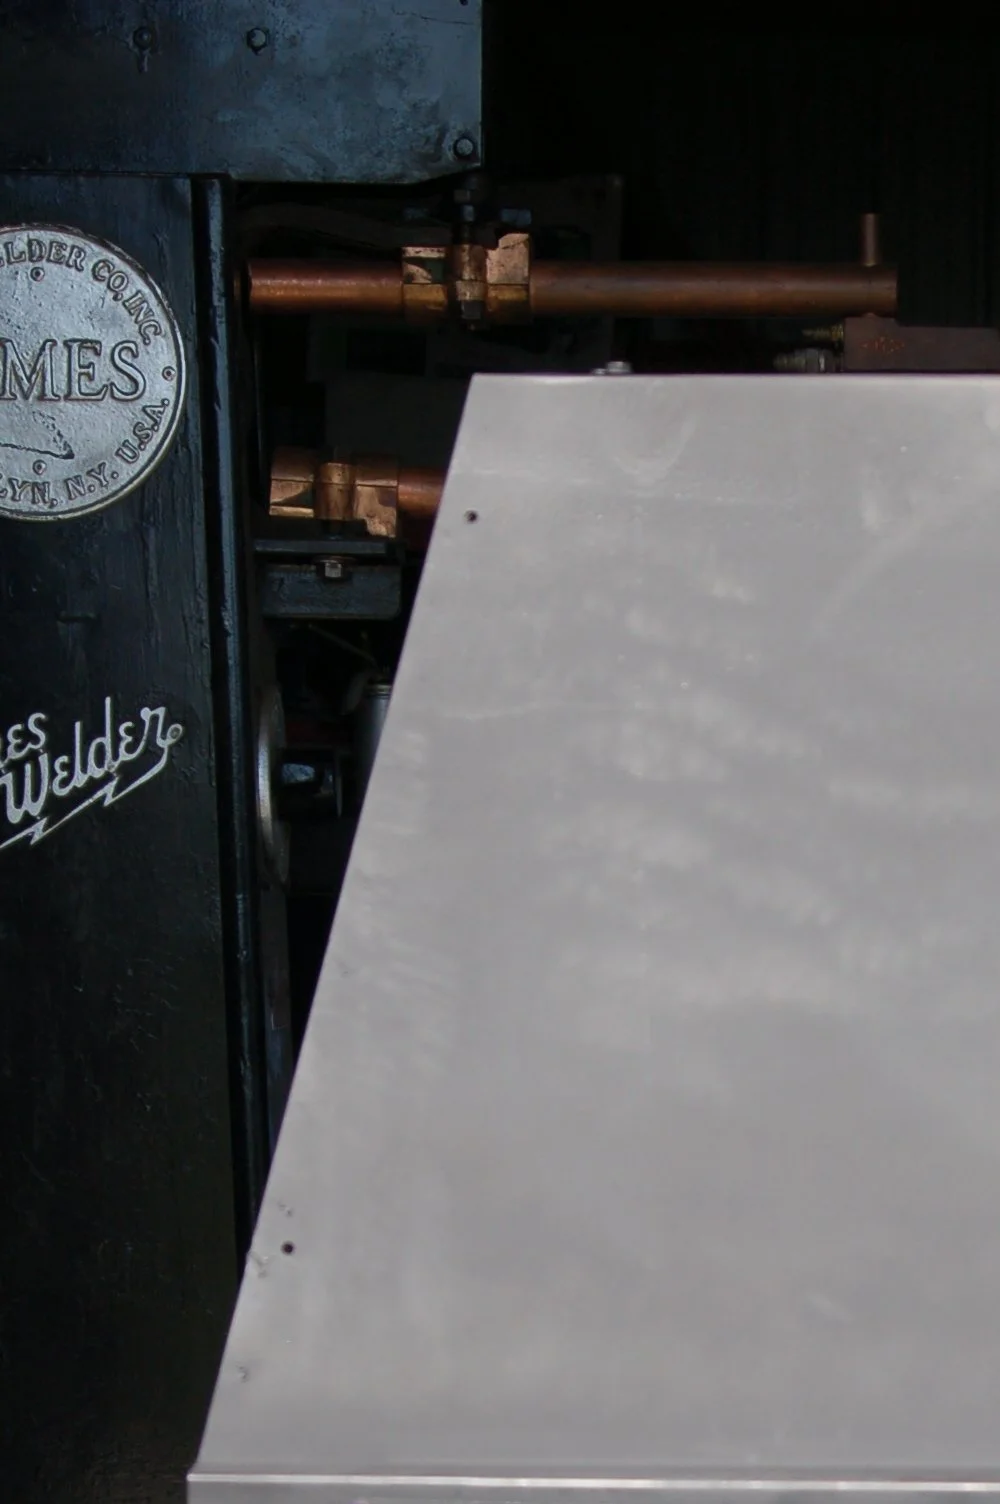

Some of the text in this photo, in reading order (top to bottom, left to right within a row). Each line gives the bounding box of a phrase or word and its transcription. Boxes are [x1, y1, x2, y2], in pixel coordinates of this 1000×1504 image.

[0, 238, 87, 272] LDER
[64, 461, 119, 500] N.Y.
[116, 398, 170, 464] U.S.A.
[0, 712, 47, 768] es
[0, 696, 183, 824] Welder
